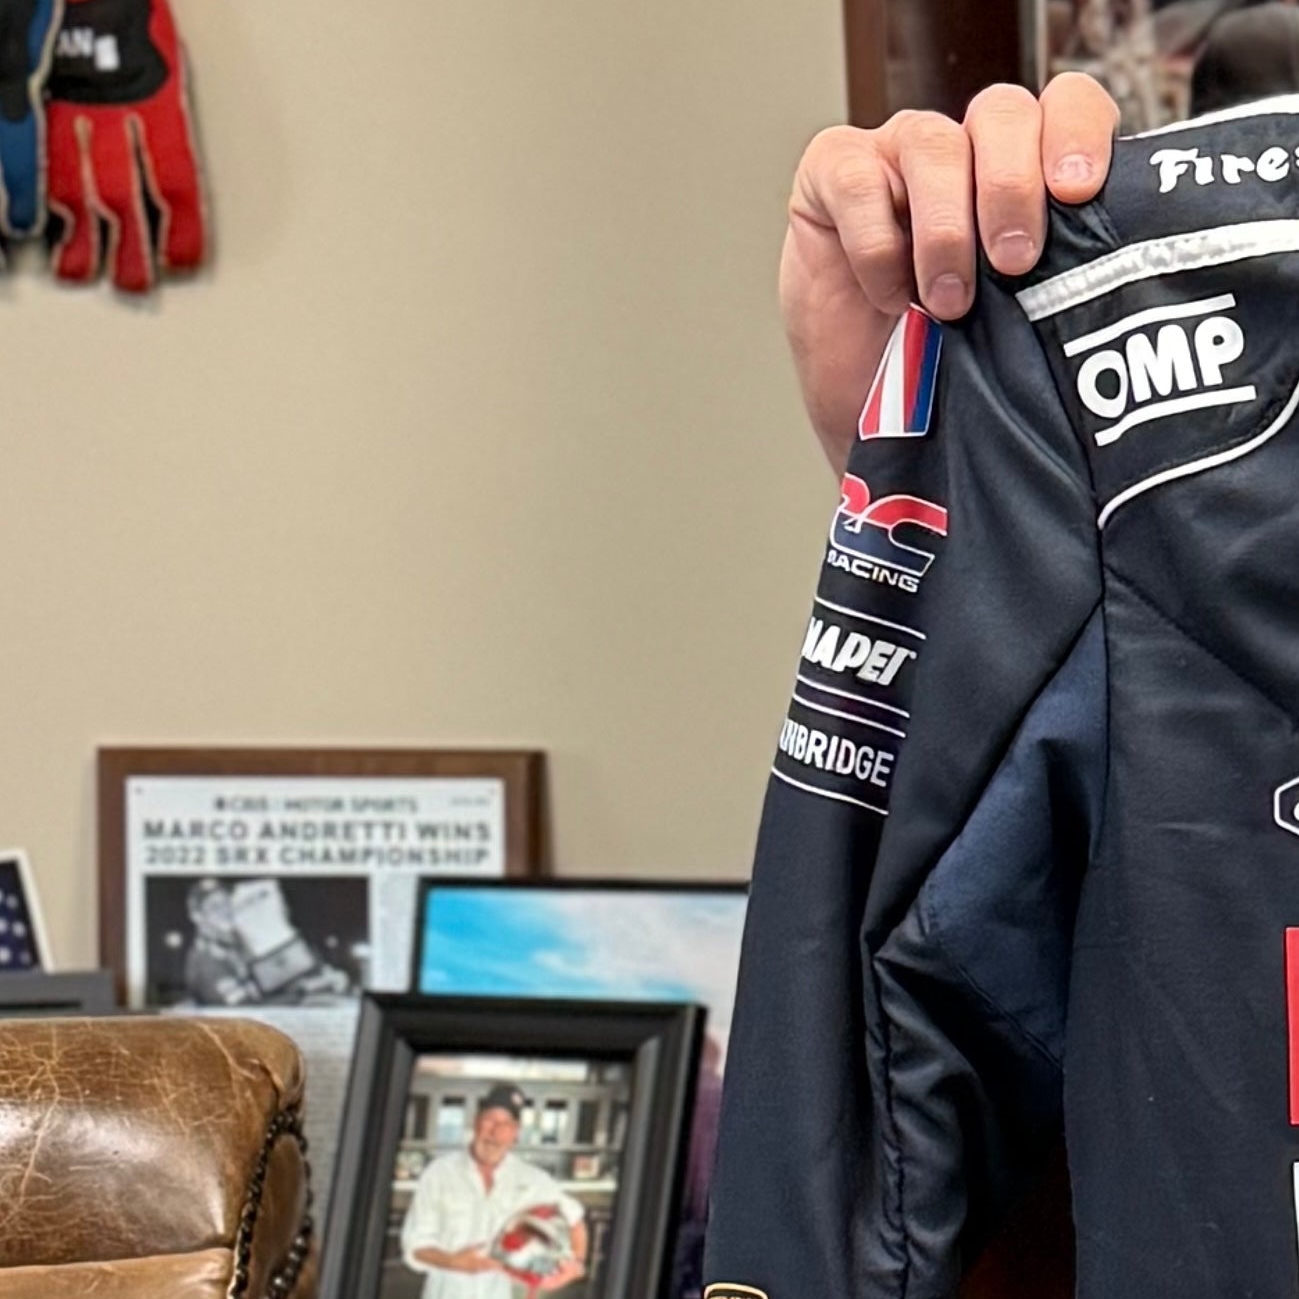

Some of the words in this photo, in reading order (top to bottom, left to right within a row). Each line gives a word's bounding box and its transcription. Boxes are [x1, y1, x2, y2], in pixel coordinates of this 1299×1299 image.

[1076, 314, 1245, 420] OMP
[143, 819, 249, 842] MARCO
[258, 821, 407, 842] ANDRETTI
[415, 821, 492, 843] WINS
[144, 847, 207, 866] 2022
[214, 847, 271, 866] SRX
[278, 847, 493, 867] CHAMPIONSHIP
